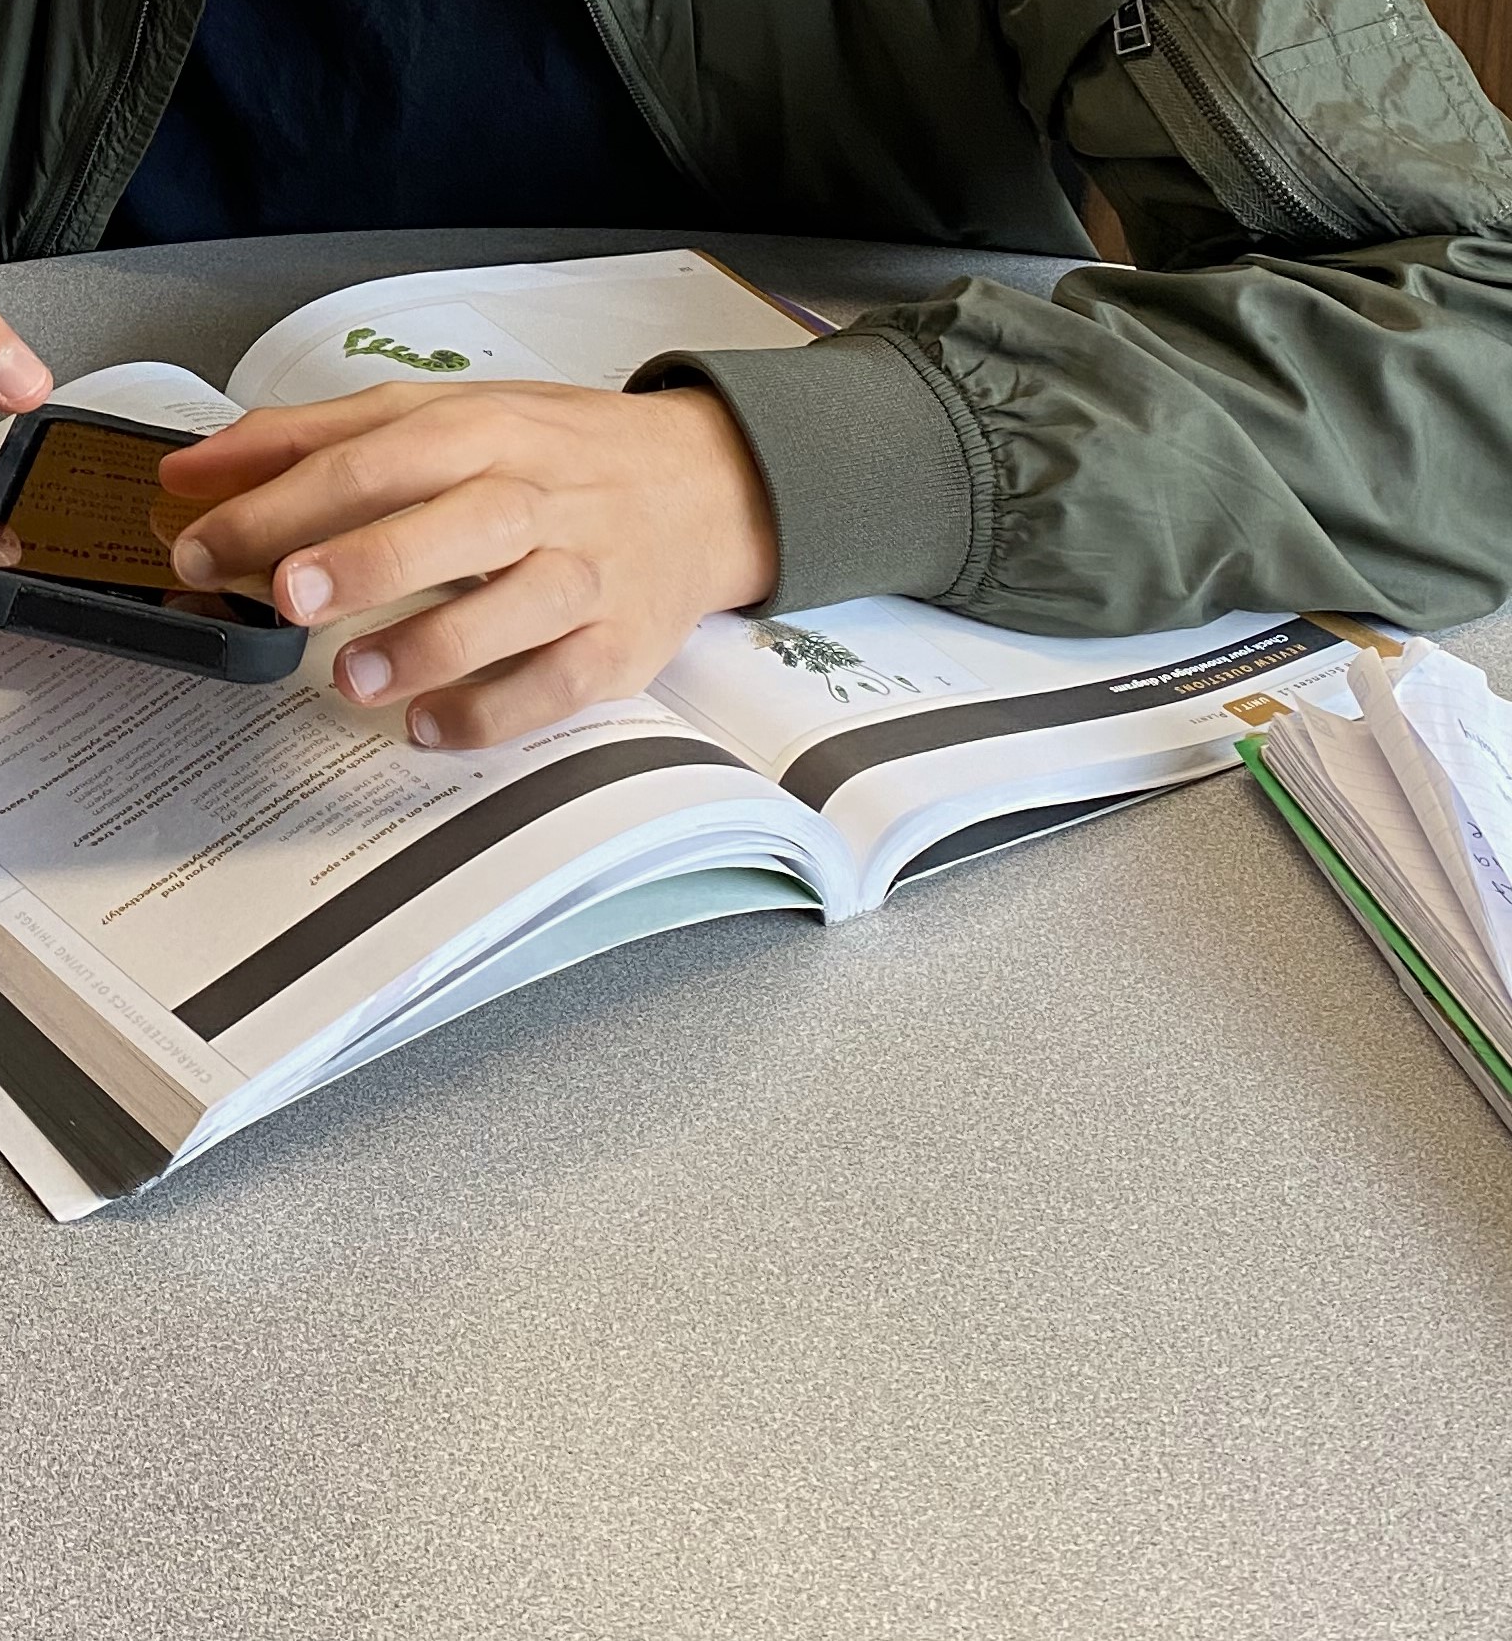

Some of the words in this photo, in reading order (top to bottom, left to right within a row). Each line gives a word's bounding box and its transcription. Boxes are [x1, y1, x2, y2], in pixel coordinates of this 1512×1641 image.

[1227, 643, 1253, 661] your
[1251, 630, 1289, 653] Check
[1169, 650, 1232, 682] knowledge
[1252, 641, 1307, 669] REVIEW
[169, 673, 193, 693] hair
[1108, 671, 1159, 699] diagrams
[1157, 671, 1172, 685] of
[1172, 661, 1253, 696] QUESTIONS
[148, 688, 172, 708] and
[276, 682, 312, 709] Which
[310, 690, 321, 700] A
[1240, 693, 1270, 711] UNIT
[131, 693, 181, 730] accounts
[133, 702, 151, 717] on
[274, 694, 313, 723] boring
[101, 722, 122, 739] the
[120, 713, 135, 727] to
[225, 703, 278, 742] sequence
[252, 718, 277, 738] tool
[568, 715, 614, 738] problem
[114, 725, 134, 741] for
[241, 733, 254, 745] is
[378, 737, 394, 751] In
[551, 728, 569, 741] for
[63, 734, 103, 764] xylem?
[95, 737, 117, 755] the
[214, 738, 228, 751] of
[215, 740, 243, 763] used
[521, 736, 552, 753] moss
[176, 747, 215, 776] tissues
[202, 758, 218, 772] to
[345, 745, 381, 772] which
[38, 750, 96, 791] movement
[179, 767, 205, 788] drill
[25, 786, 40, 800] of
[142, 773, 178, 800] would
[298, 765, 347, 801] growing
[133, 796, 144, 807] it
[145, 790, 173, 811] hole
[335, 788, 354, 805] tip
[371, 782, 405, 809] Along
[418, 781, 461, 813] Where
[121, 807, 147, 828] into
[239, 797, 302, 841] conditions
[352, 804, 374, 822] the
[359, 803, 395, 831] flower
[406, 805, 422, 819] on
[70, 803, 134, 849] encounter?
[233, 814, 257, 834] and
[277, 813, 318, 845] branch
[325, 816, 355, 839] stem
[366, 821, 398, 846] plant
[174, 828, 237, 875] halophytes
[205, 838, 244, 868] would
[340, 848, 357, 863] an
[355, 841, 369, 854] is
[183, 862, 206, 881] you
[304, 858, 340, 888] apex?
[97, 869, 179, 926] (respectively)?
[159, 878, 186, 899] find
[13, 907, 58, 950] THINGS
[54, 943, 95, 983] LIVING
[91, 977, 112, 997] OF
[108, 991, 214, 1088] CHARACTERISTICS
